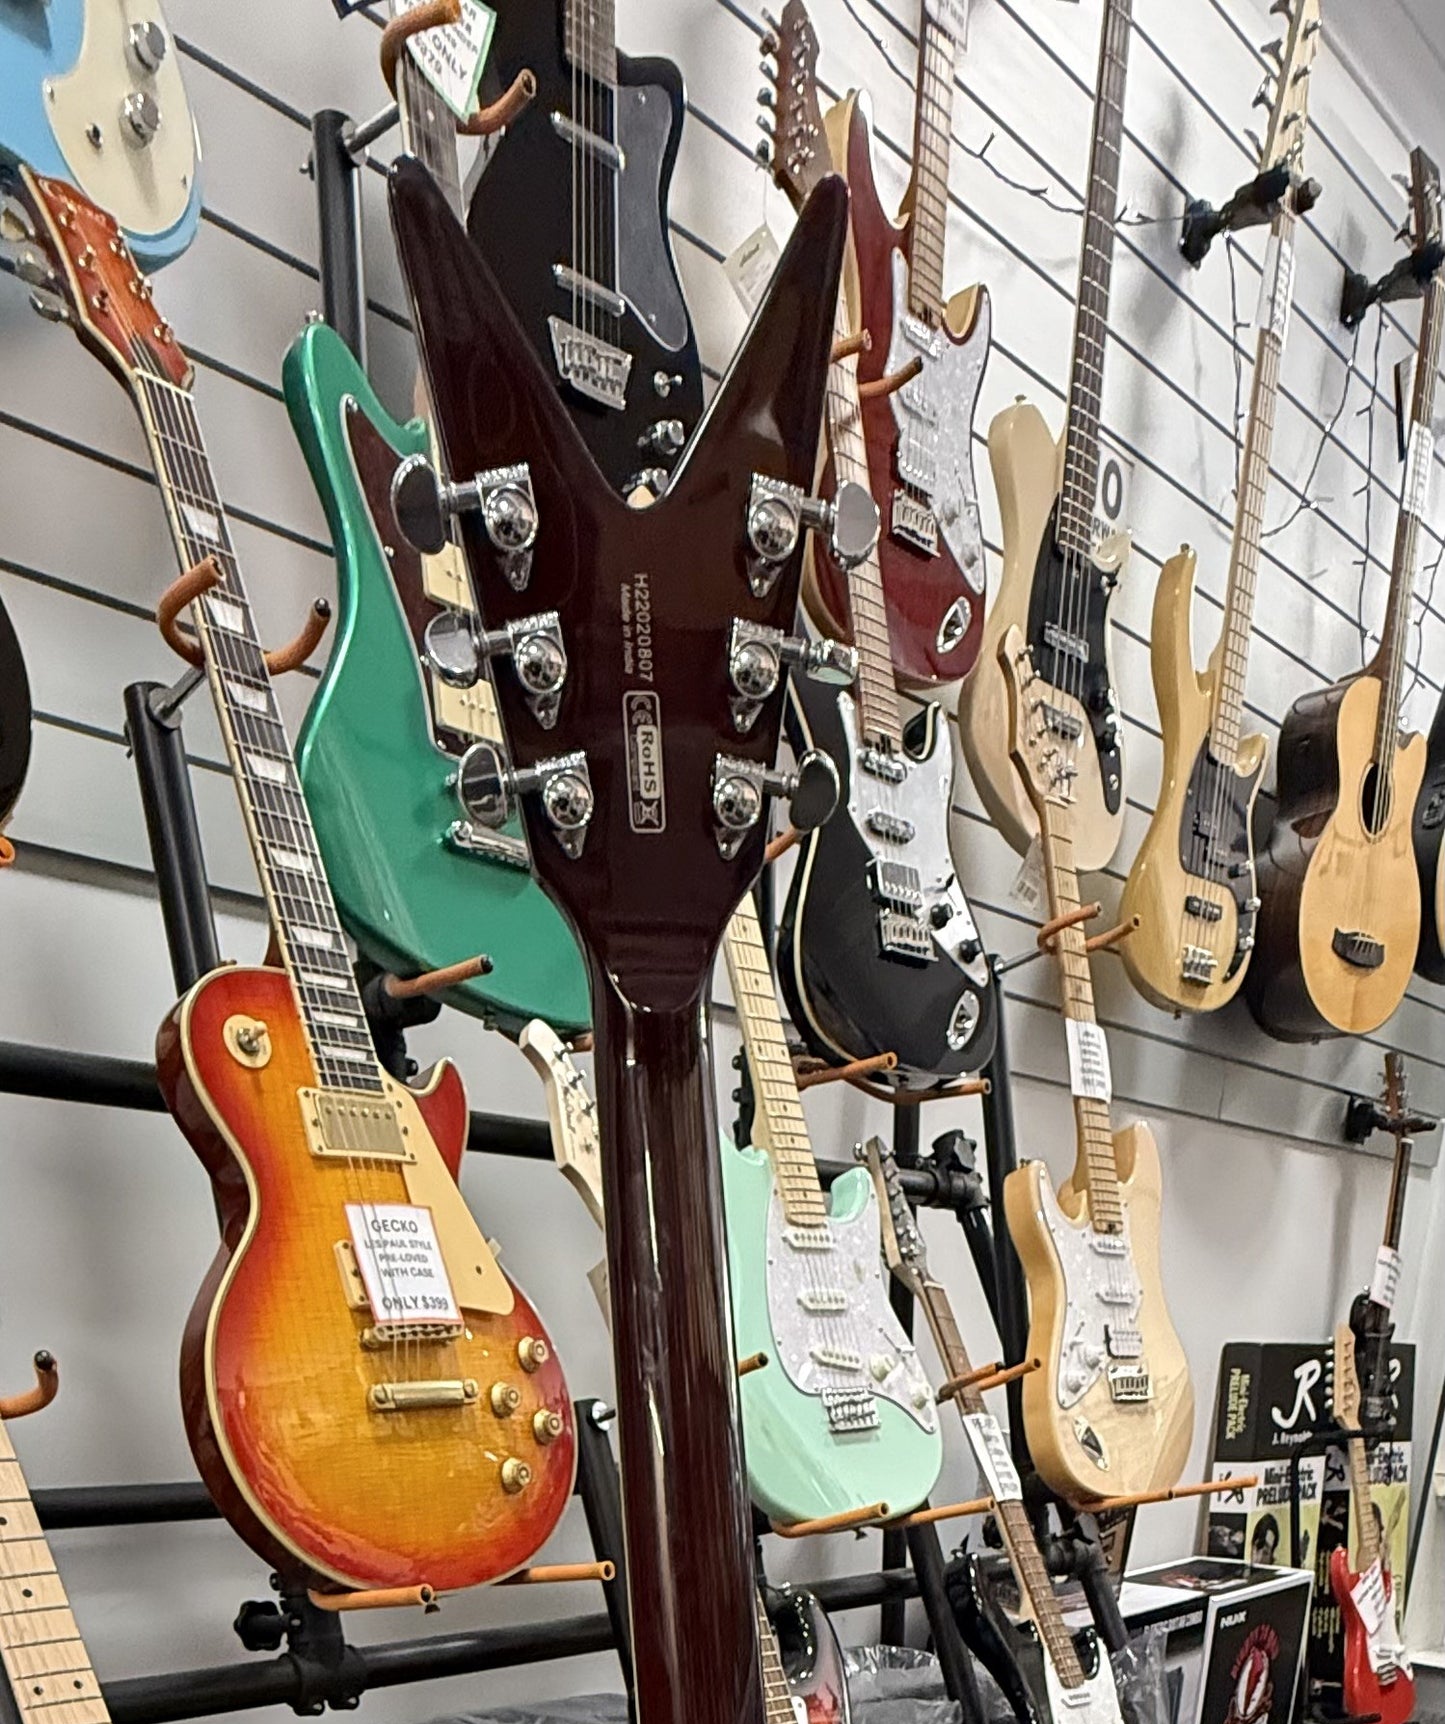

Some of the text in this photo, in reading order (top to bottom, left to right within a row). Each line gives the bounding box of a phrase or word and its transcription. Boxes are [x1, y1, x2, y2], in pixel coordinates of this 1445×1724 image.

[620, 582, 635, 675] Made in India
[633, 572, 654, 683] H22020807
[640, 730, 657, 793] RoHS
[370, 1218, 418, 1233] GECKO
[384, 1239, 408, 1250] PAUL
[409, 1240, 433, 1251] STYLE
[378, 1253, 428, 1263] PRE-LOVED
[381, 1267, 435, 1279] WITH CASE
[381, 1296, 449, 1311] ONLY $399
[1220, 1611, 1247, 1630] NUX
